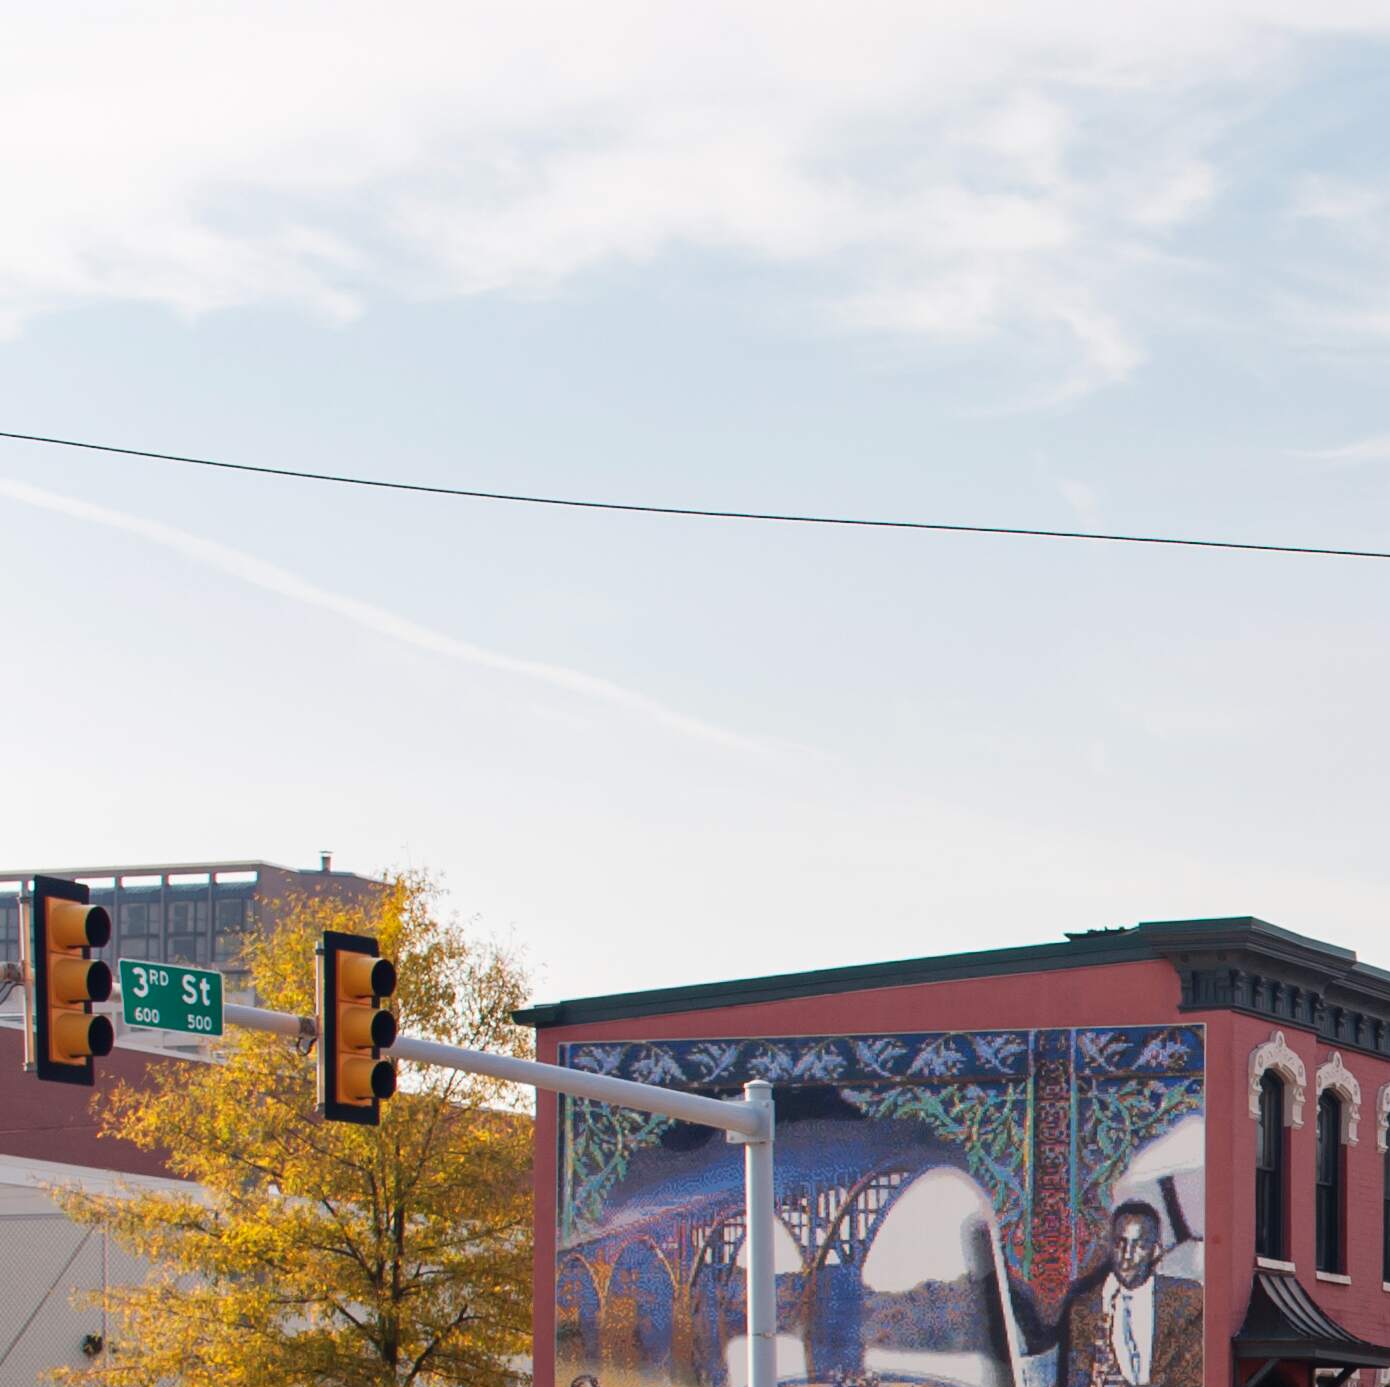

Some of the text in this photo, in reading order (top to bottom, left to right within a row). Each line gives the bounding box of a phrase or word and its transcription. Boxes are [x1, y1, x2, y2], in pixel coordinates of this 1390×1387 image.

[132, 967, 211, 1006] 3RD St
[134, 1007, 212, 1031] 600 500
